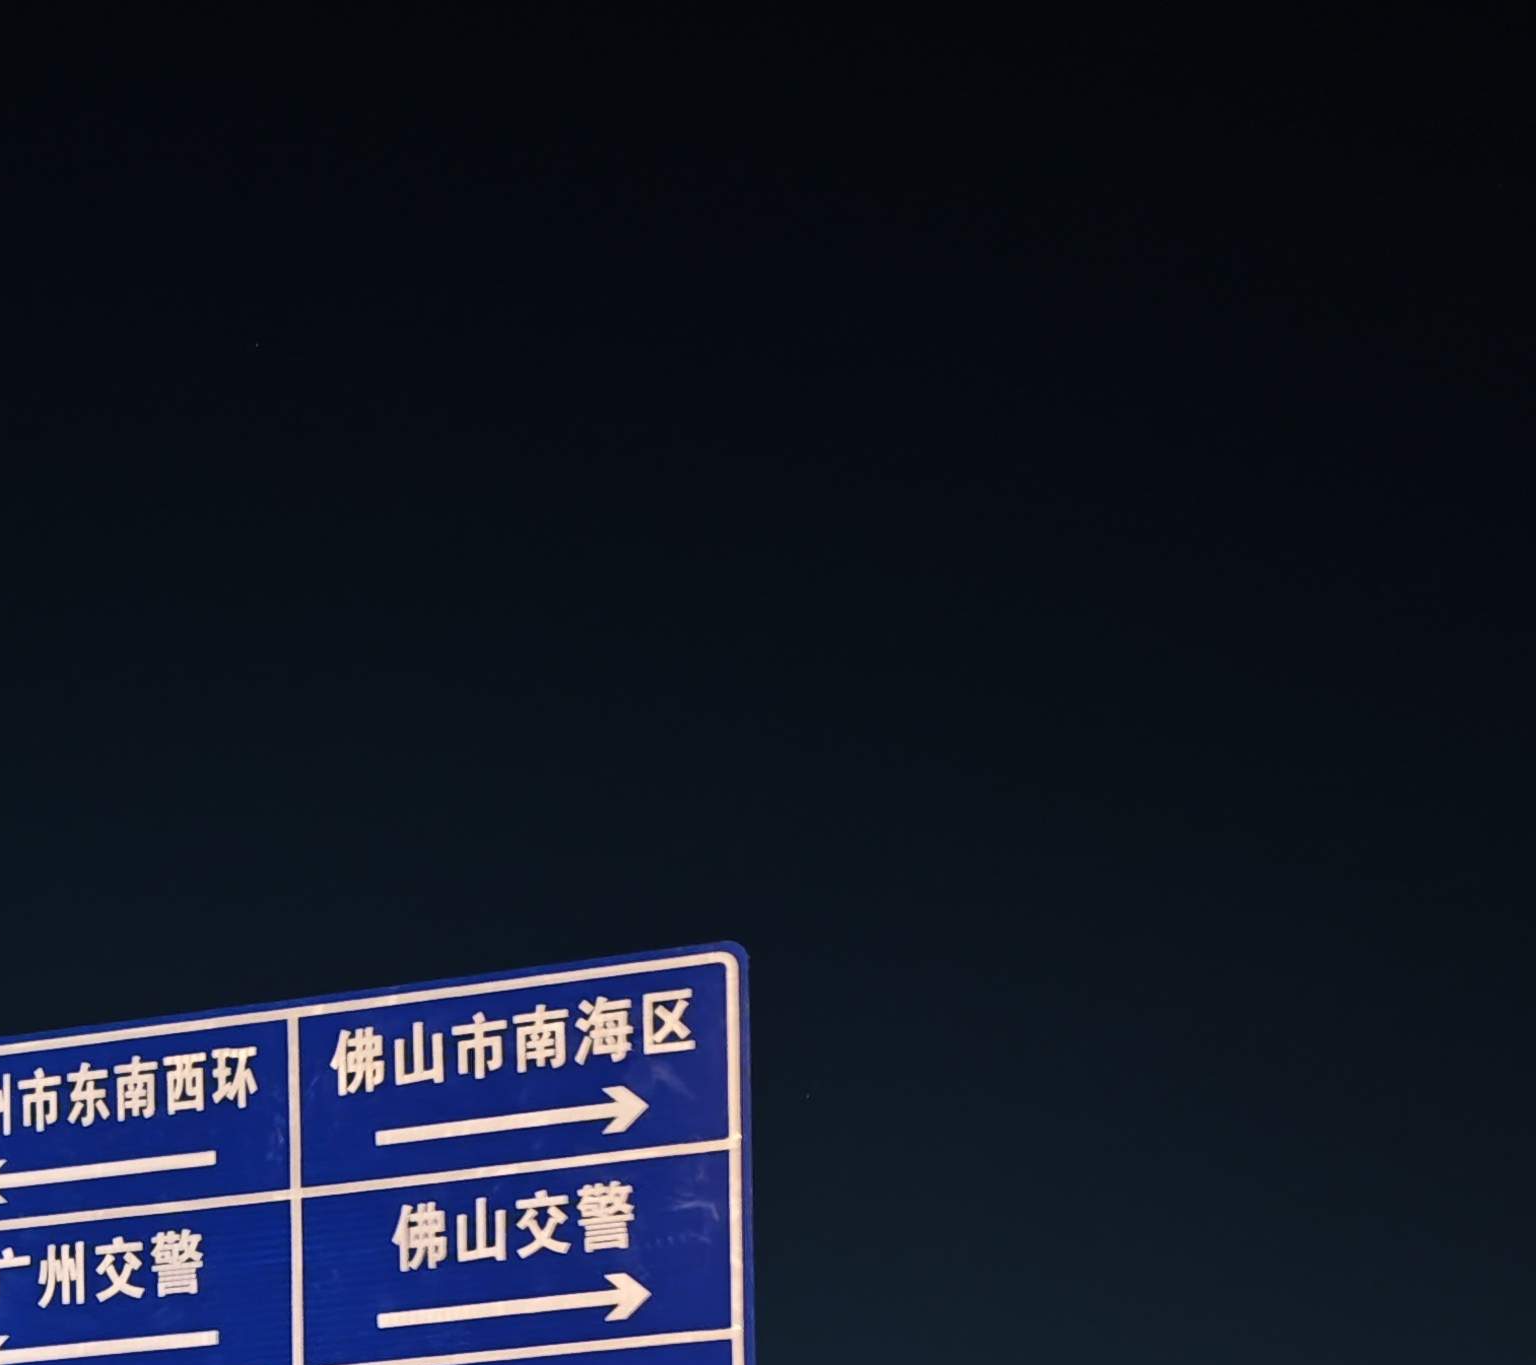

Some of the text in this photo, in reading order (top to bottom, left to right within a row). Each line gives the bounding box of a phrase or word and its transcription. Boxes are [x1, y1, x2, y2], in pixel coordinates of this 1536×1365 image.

[330, 988, 696, 1096] 佛山市南海区
[392, 1180, 635, 1273] 佛山交警
